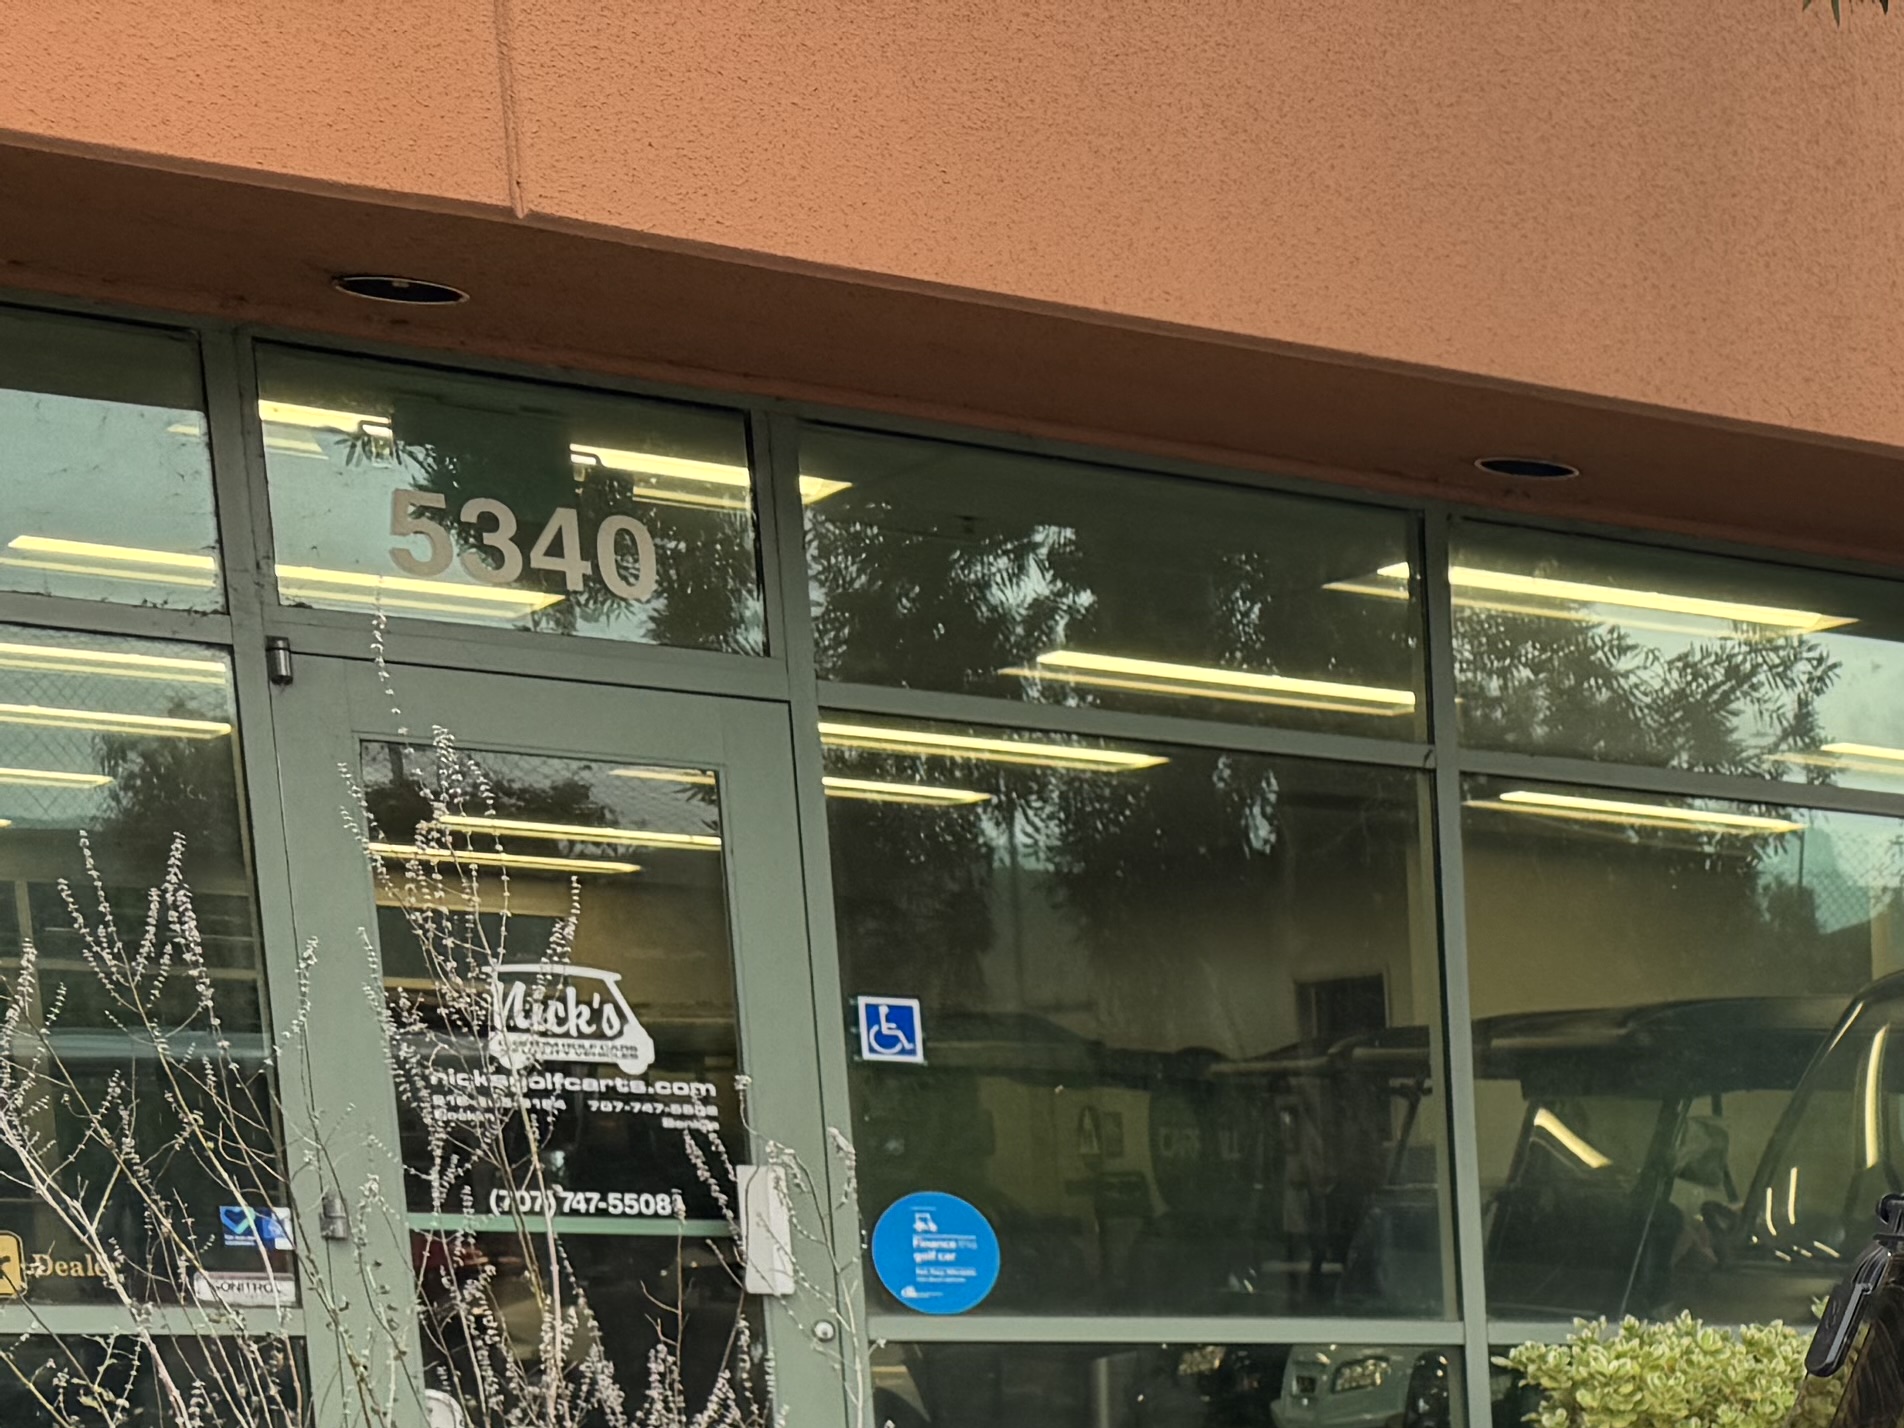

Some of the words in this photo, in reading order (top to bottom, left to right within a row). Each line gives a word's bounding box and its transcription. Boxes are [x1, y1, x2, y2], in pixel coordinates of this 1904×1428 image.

[388, 488, 657, 601] 5340
[562, 1191, 671, 1216] 747-5508
[31, 1253, 122, 1278] Deale
